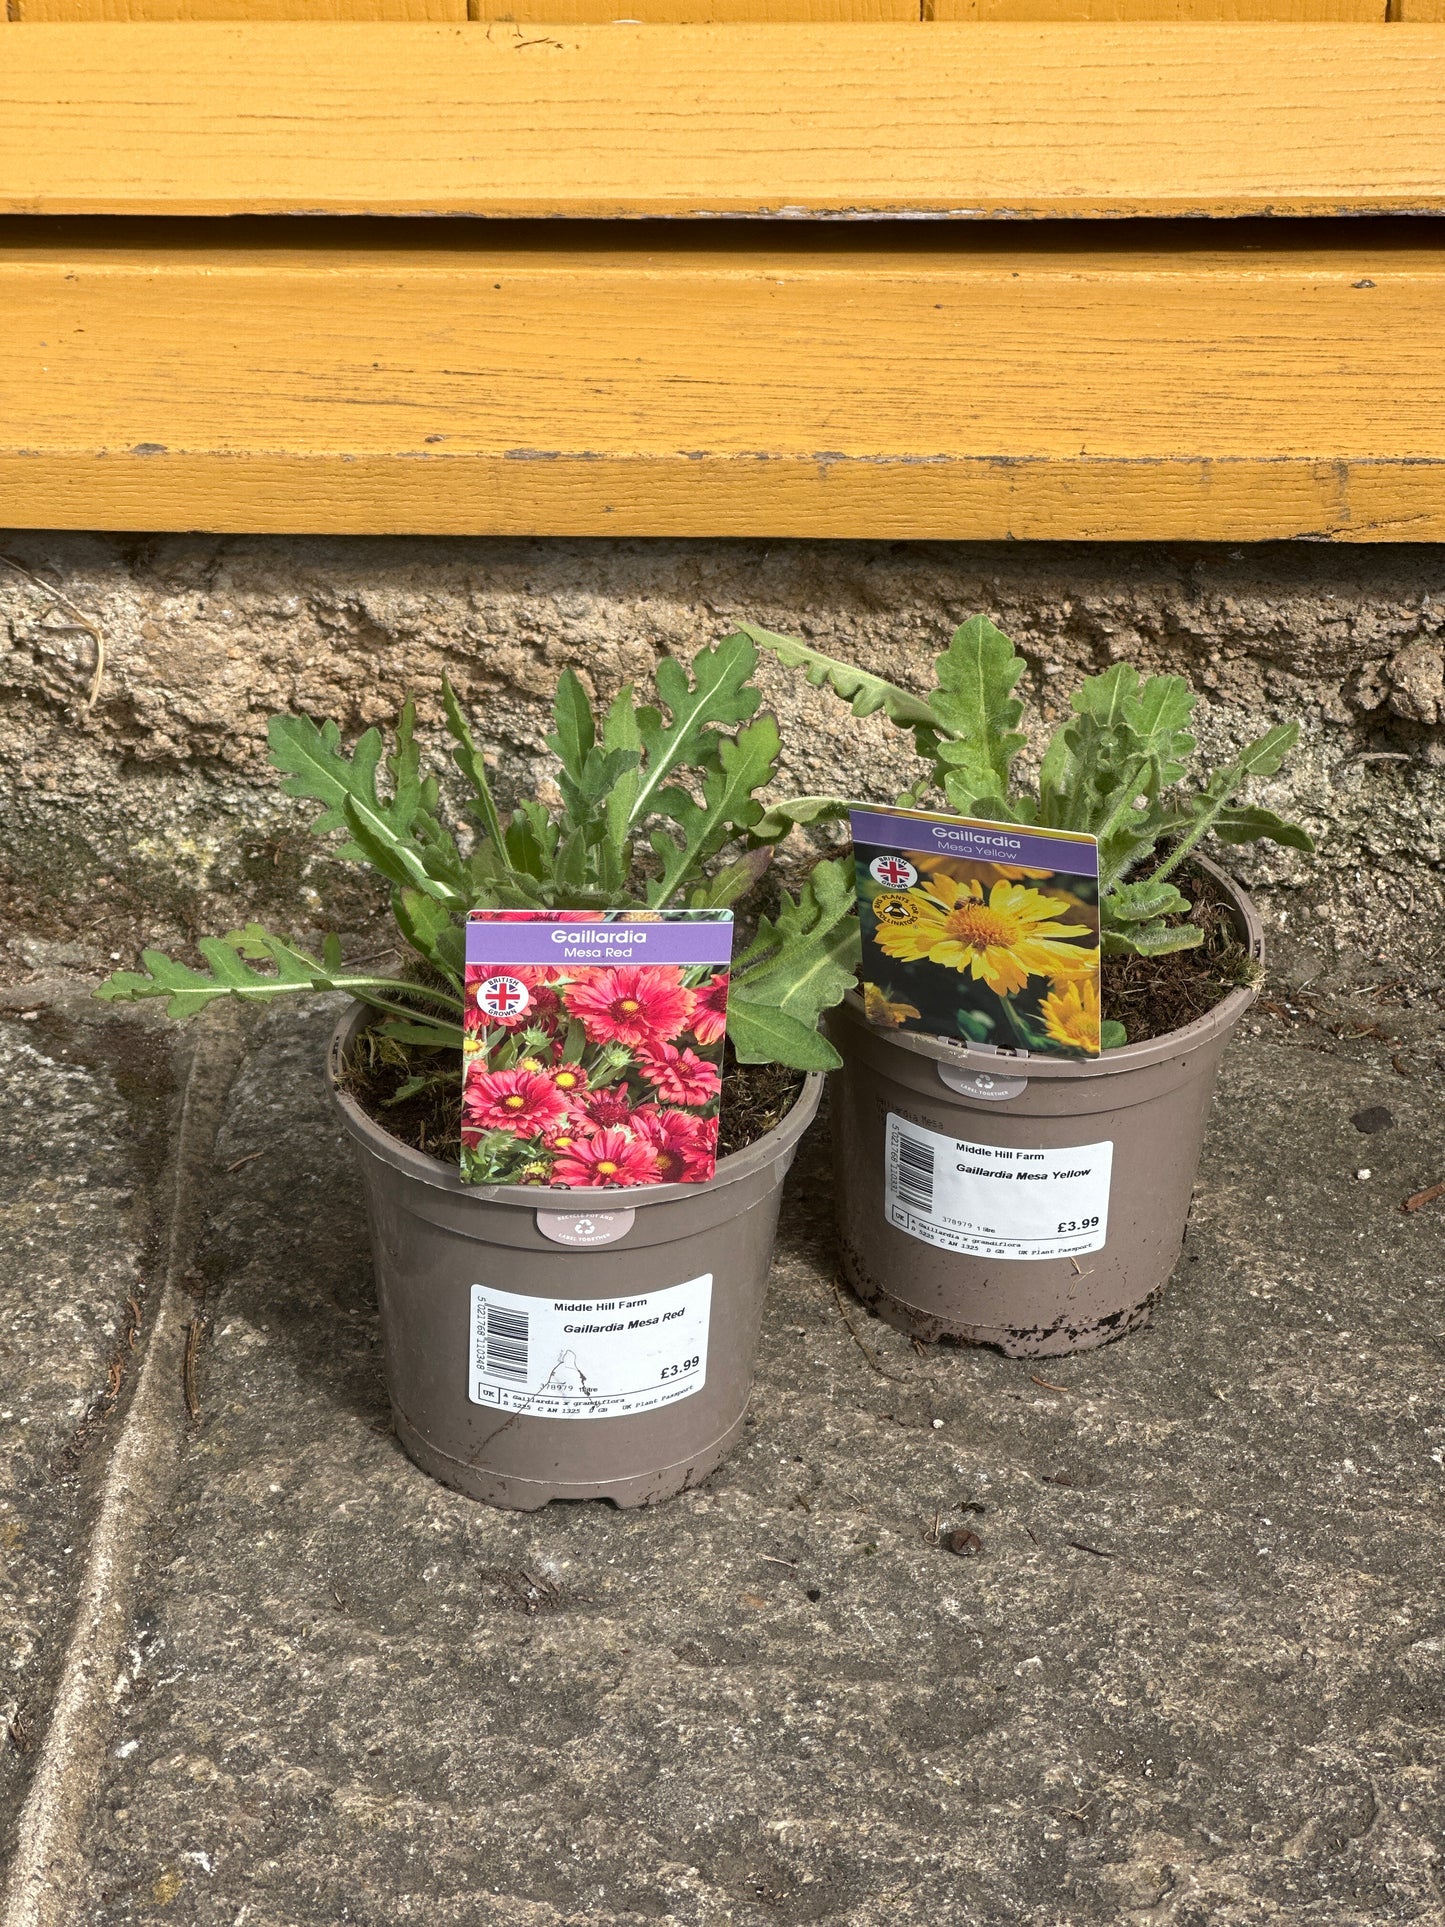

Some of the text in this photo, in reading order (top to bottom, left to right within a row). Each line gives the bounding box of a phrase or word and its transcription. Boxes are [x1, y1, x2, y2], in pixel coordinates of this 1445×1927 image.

[932, 827, 1021, 849] Gaillardia
[937, 841, 1017, 860] Mesa Yellow
[878, 856, 908, 866] BRITISH
[881, 880, 909, 889] GROWN
[881, 894, 909, 904] PLANTS
[551, 930, 647, 944] Gaillardia
[564, 947, 632, 958] Mesa Red
[487, 977, 520, 986] BRITISH
[488, 1008, 518, 1016] GROWN
[960, 1083, 978, 1094] LABEL
[956, 1142, 1045, 1160] Middle Hill Farm
[956, 1163, 1092, 1180] Gaillardia Mesa Yellow
[942, 1216, 973, 1228] 378979
[1057, 1216, 1100, 1233] £3.99
[558, 1232, 611, 1242] LABEL TOGETHER
[971, 1238, 1021, 1247] grandiflora
[961, 1243, 979, 1251] 1325
[1057, 1242, 1093, 1253] Passport
[554, 1298, 648, 1312] Middle Hill Farm
[563, 1307, 686, 1334] Gaillardia Mesa Red
[660, 1355, 700, 1379] £3.99
[482, 1389, 495, 1398] UK
[635, 1398, 658, 1408] Plant
[661, 1385, 694, 1401] Passport
[512, 1395, 560, 1406] Gaillardia
